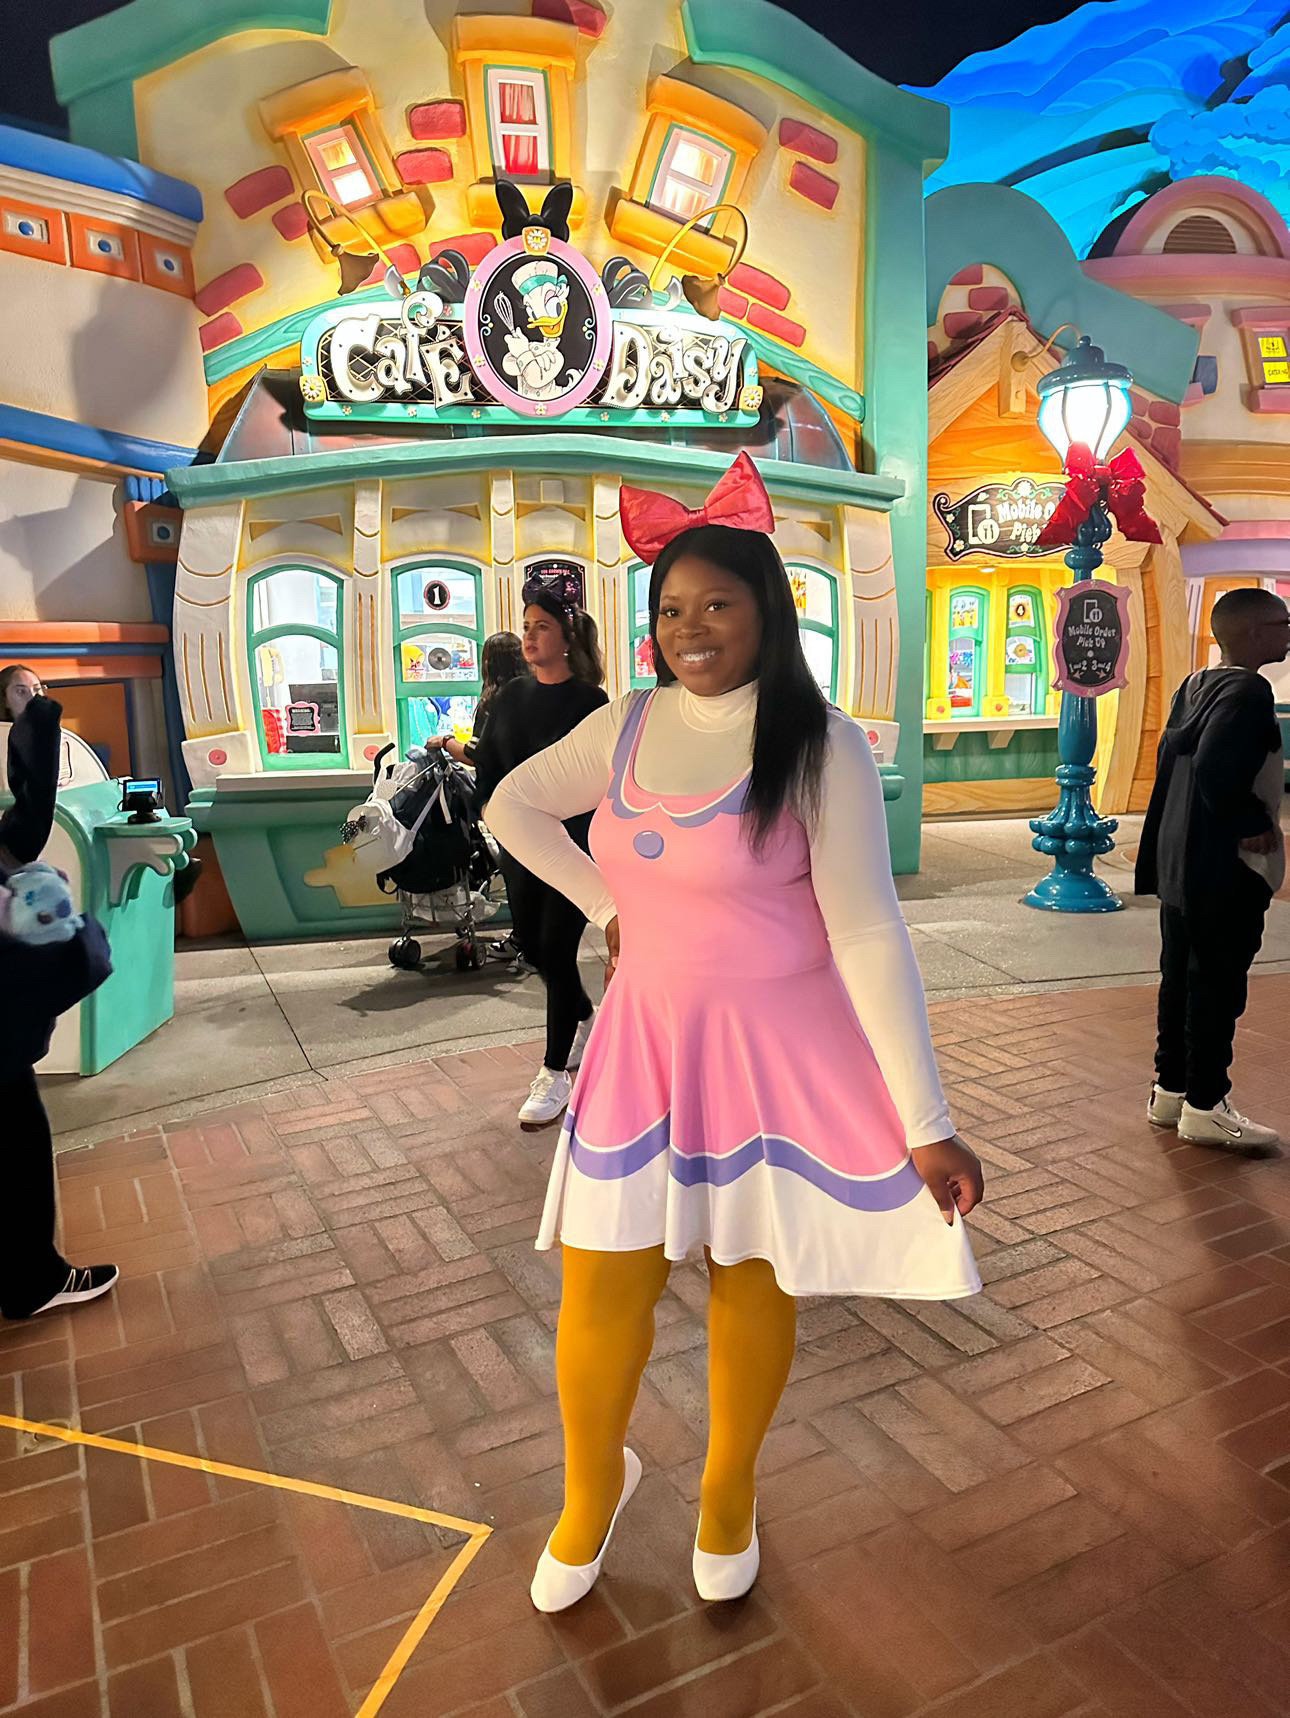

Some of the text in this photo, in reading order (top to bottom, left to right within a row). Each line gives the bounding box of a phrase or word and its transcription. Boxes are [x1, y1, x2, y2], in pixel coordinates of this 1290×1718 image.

[599, 320, 748, 413] Daisy
[996, 498, 1043, 524] Mobile
[433, 585, 441, 605] 1
[1068, 624, 1116, 637] Mobile Order
[1076, 636, 1094, 648] Pick
